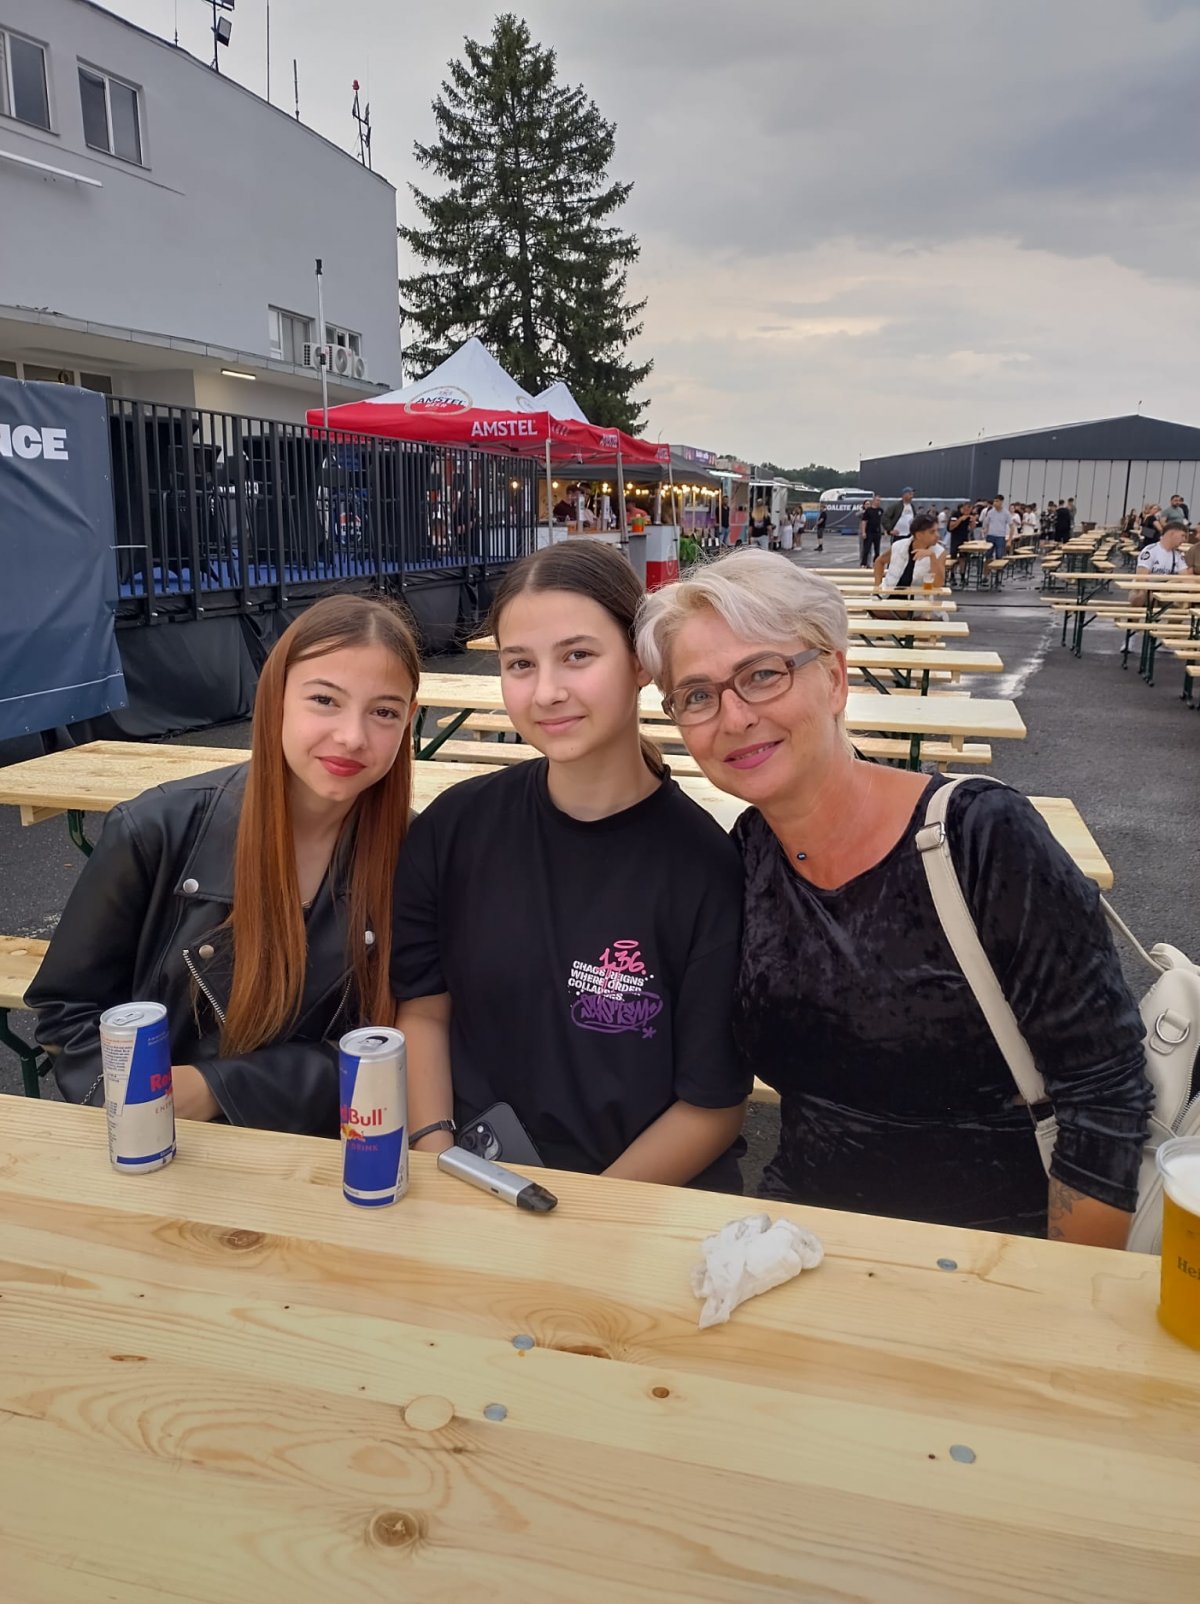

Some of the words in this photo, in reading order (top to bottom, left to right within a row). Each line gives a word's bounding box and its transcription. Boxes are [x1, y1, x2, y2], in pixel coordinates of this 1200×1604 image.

[415, 396, 468, 407] AMSTEL
[471, 420, 538, 437] AMSTEL
[825, 503, 853, 511] OALETE
[570, 968, 606, 986] WHERE
[607, 981, 643, 996] ORDER
[572, 960, 606, 977] CHAOS
[609, 971, 645, 987] REIGNS
[347, 1107, 382, 1127] Bull
